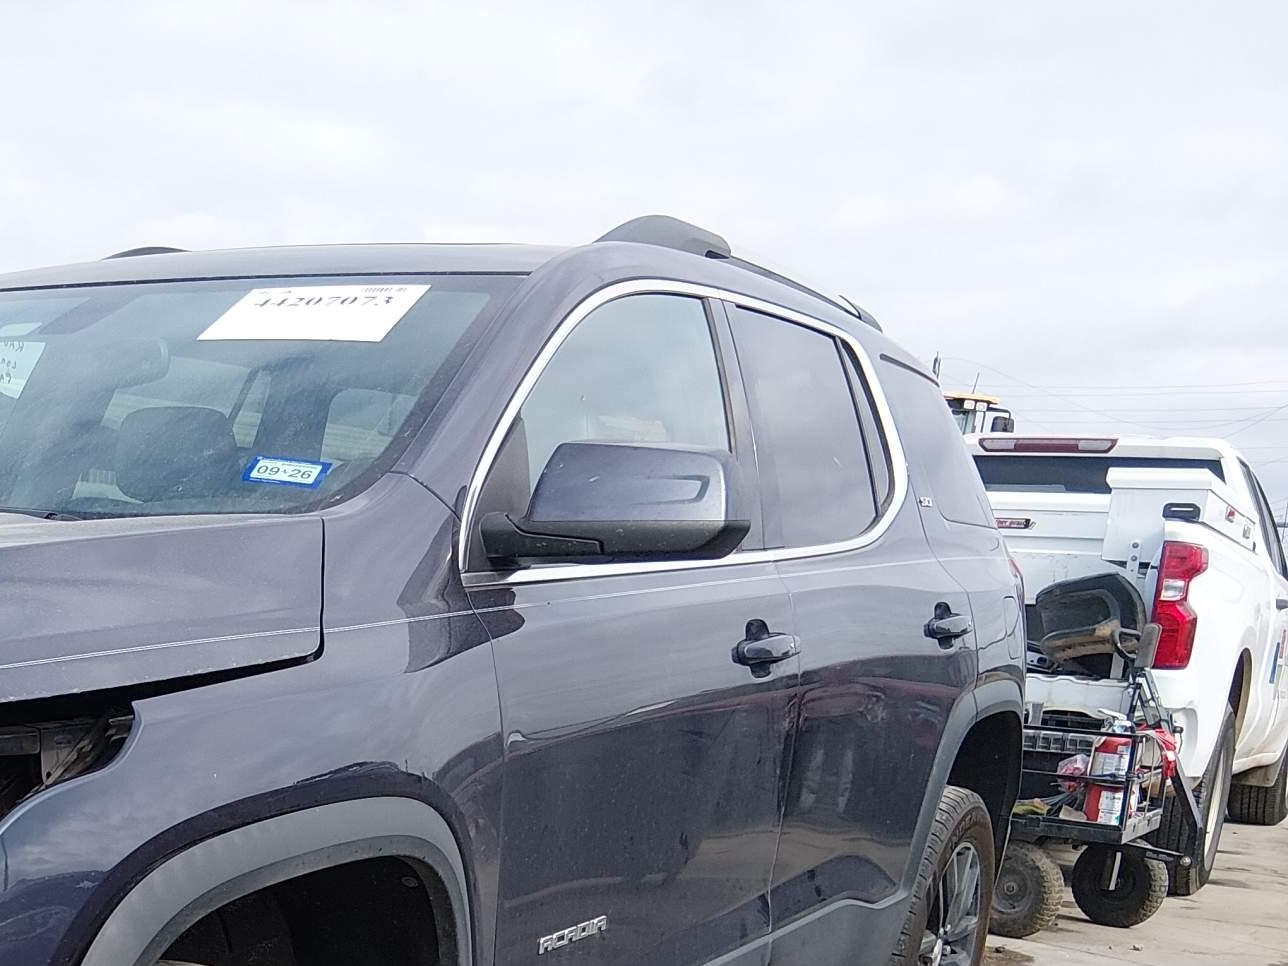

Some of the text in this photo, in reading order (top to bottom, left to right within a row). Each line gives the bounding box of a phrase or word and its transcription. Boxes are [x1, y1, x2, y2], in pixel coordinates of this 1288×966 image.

[254, 295, 394, 307] 44207073
[256, 465, 314, 480] 09 26
[537, 914, 607, 955] ACADIA
